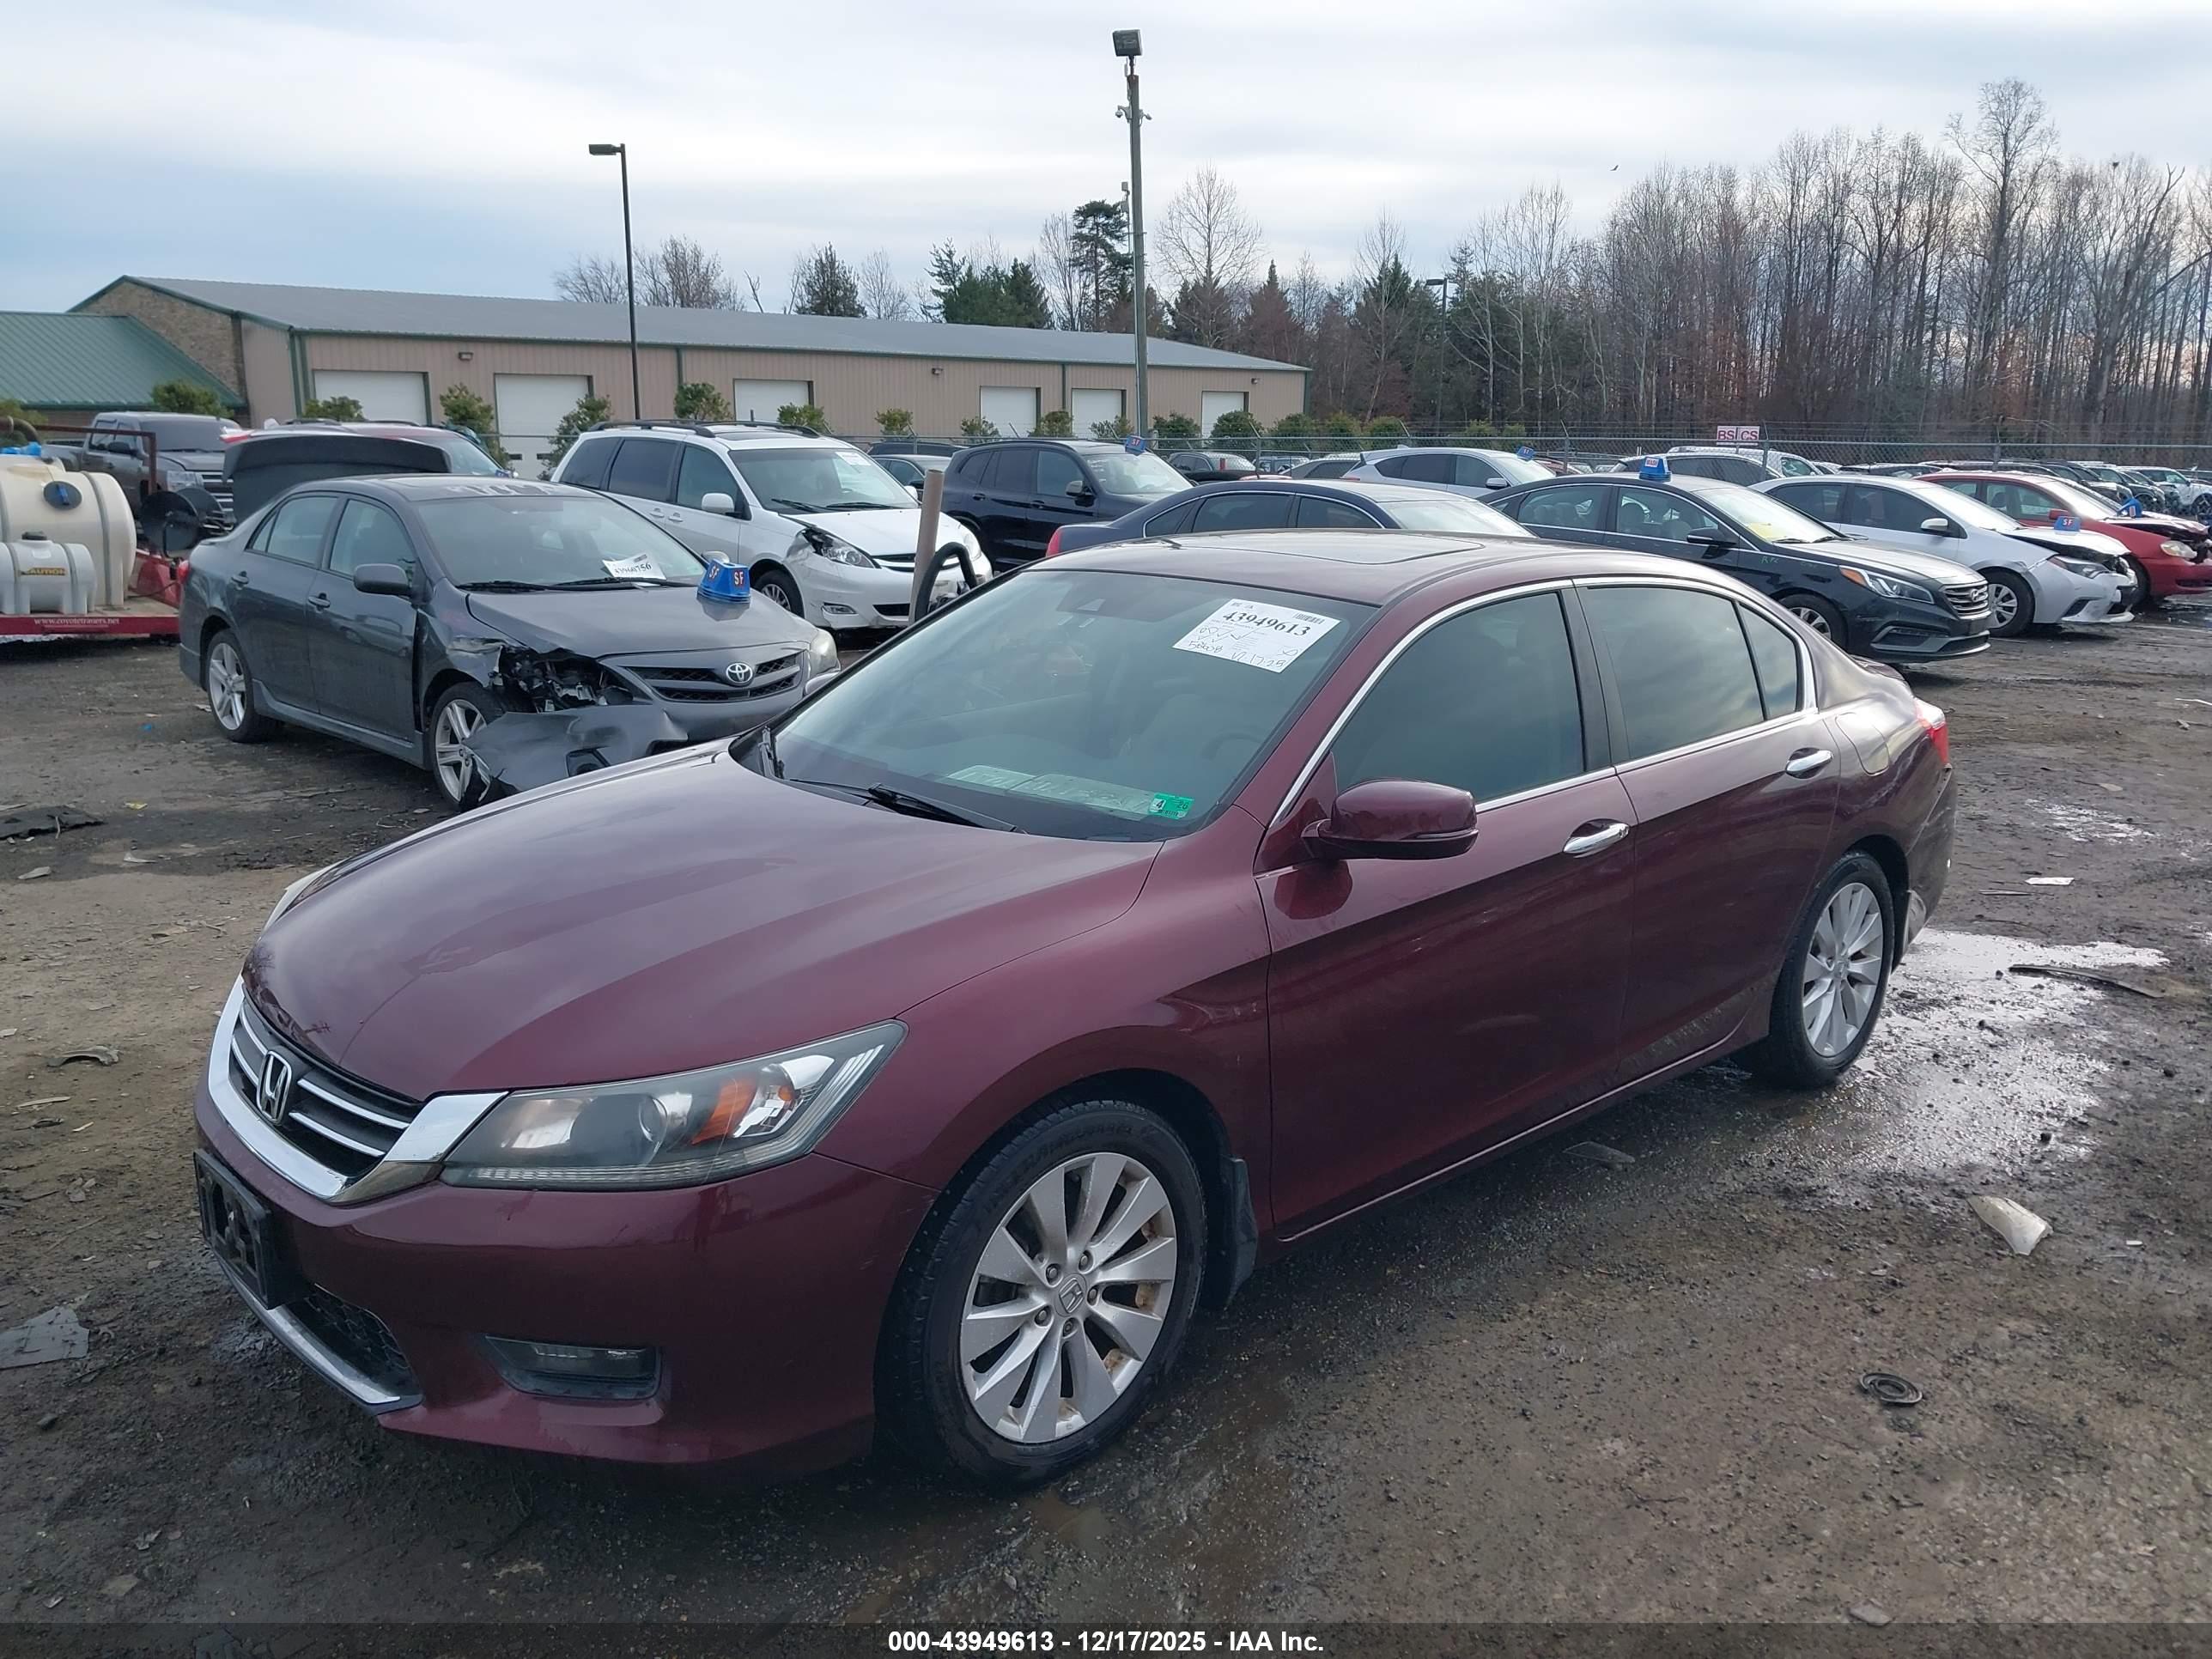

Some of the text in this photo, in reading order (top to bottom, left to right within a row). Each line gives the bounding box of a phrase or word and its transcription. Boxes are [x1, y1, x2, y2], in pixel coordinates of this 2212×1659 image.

[1718, 430, 1759, 440] BS CS
[2063, 518, 2073, 526] SF
[708, 565, 720, 579] SF
[734, 570, 744, 586] SF
[1223, 611, 1311, 636] 43949613
